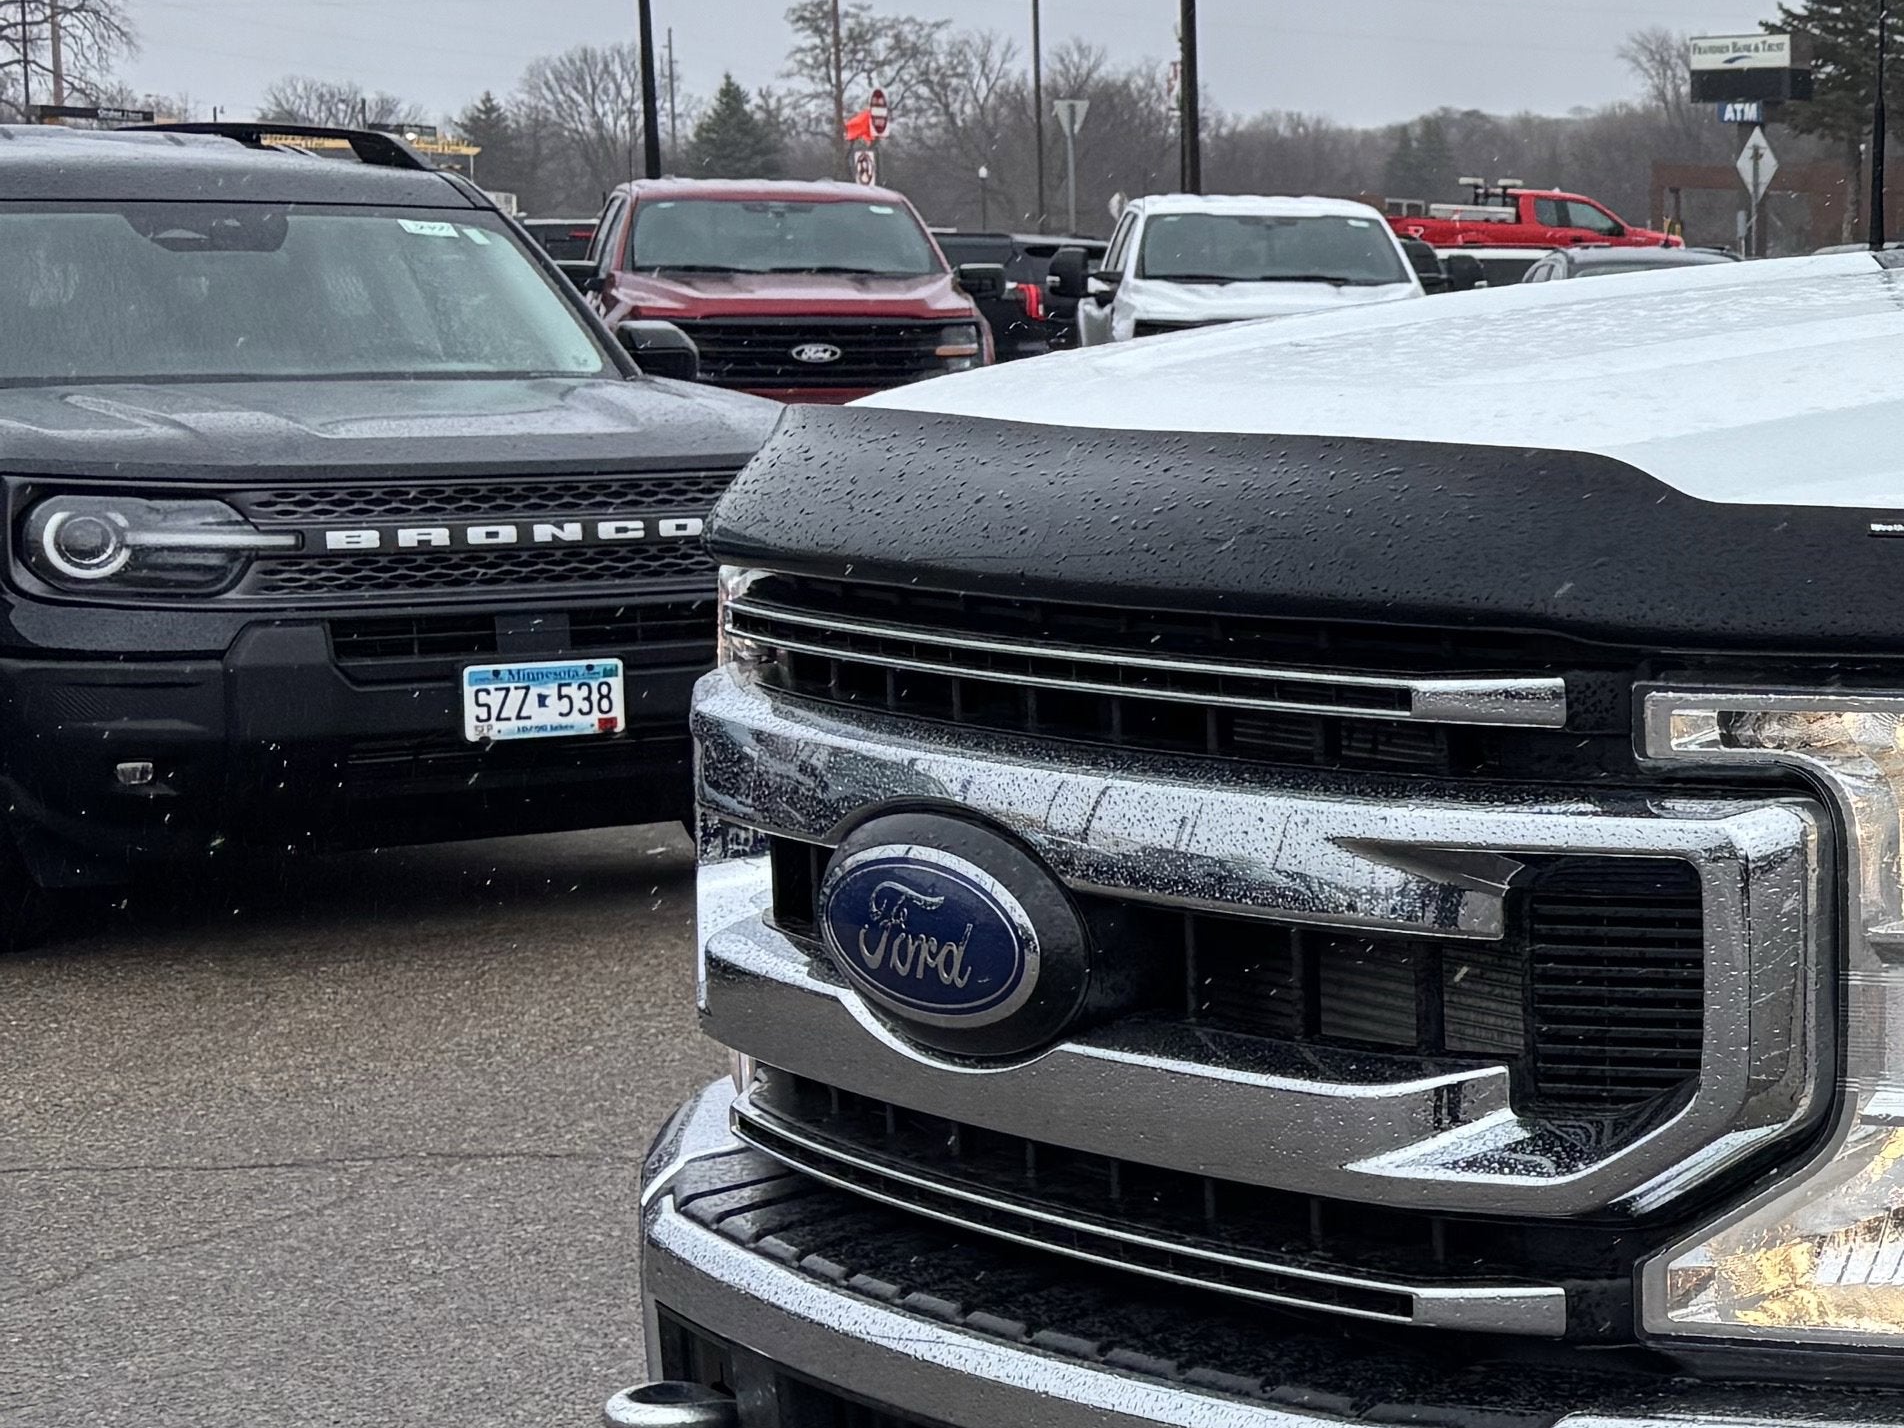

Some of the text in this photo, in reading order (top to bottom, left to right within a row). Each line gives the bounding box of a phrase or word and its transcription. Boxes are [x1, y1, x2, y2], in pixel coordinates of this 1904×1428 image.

[1724, 102, 1758, 122] ATM
[326, 517, 703, 549] BRONCO
[507, 668, 580, 682] Minnesota
[474, 681, 613, 723] SZZ 538
[858, 880, 975, 989] Ford
